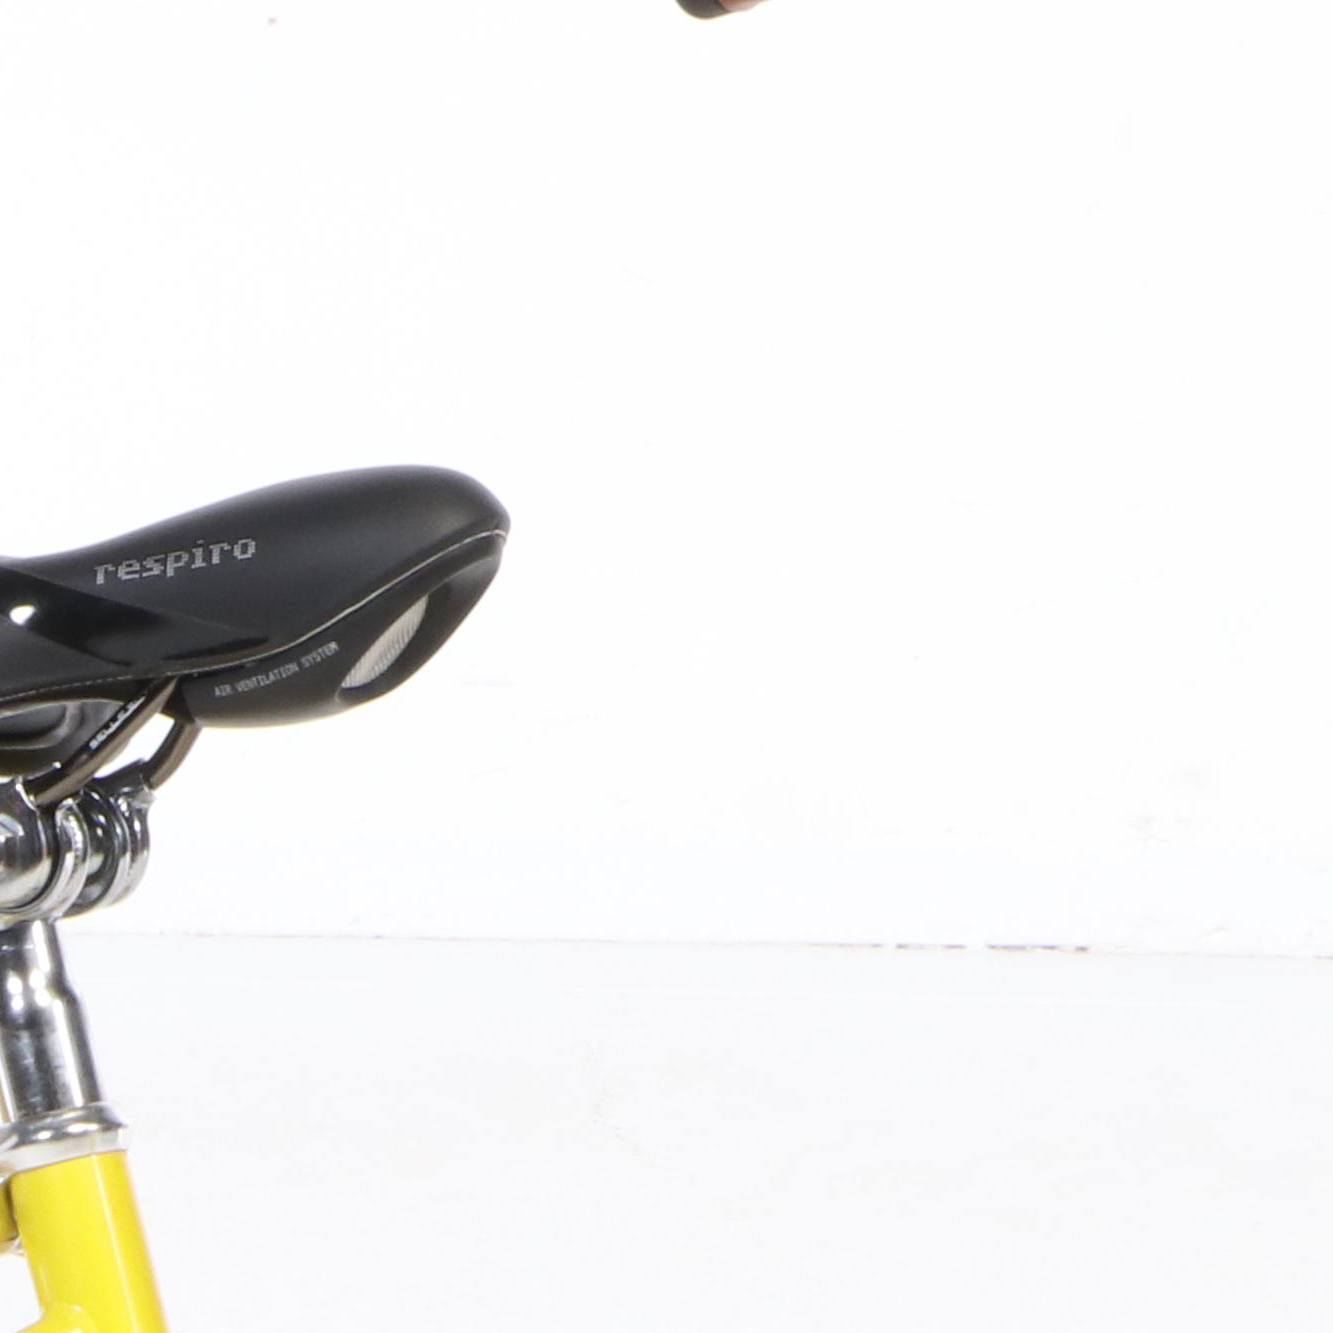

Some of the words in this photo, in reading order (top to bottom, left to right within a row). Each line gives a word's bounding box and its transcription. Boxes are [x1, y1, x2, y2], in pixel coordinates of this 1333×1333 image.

[94, 538, 256, 585] respiro
[214, 684, 232, 697] AIR
[235, 661, 299, 693] VENTILATION
[300, 641, 339, 668] SYSTEM
